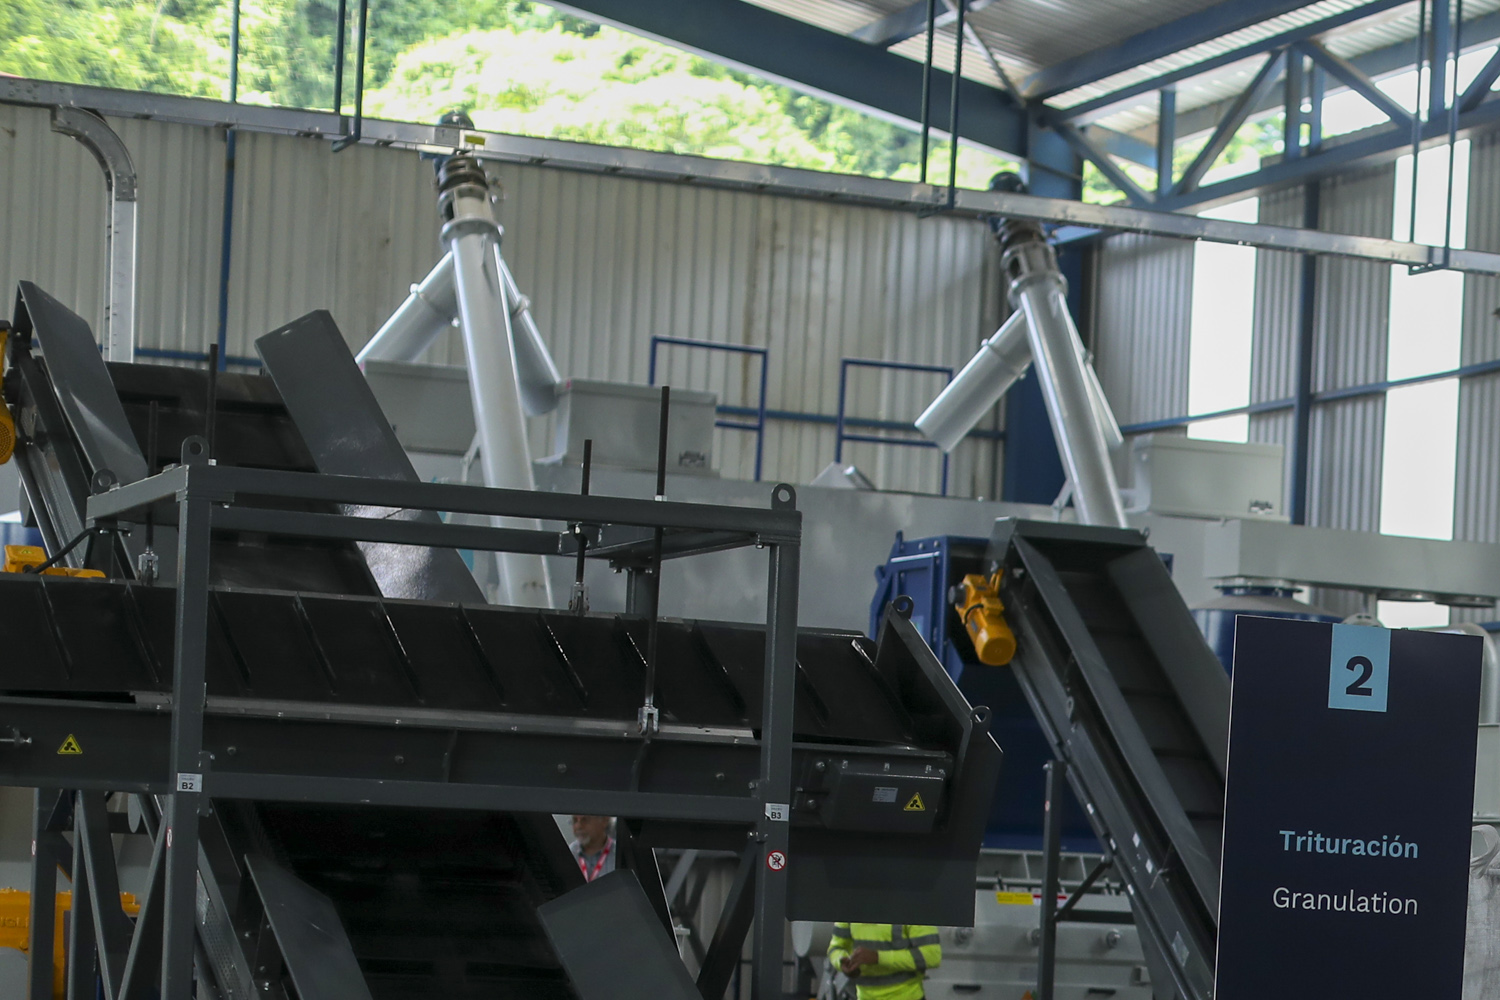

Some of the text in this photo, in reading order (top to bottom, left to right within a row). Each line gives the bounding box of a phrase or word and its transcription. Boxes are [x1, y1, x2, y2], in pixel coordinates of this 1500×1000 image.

[1345, 655, 1373, 696] 2
[181, 781, 194, 790] B2
[771, 811, 782, 820] B3
[1279, 830, 1419, 859] Trituración
[1272, 886, 1418, 915] Granulation
